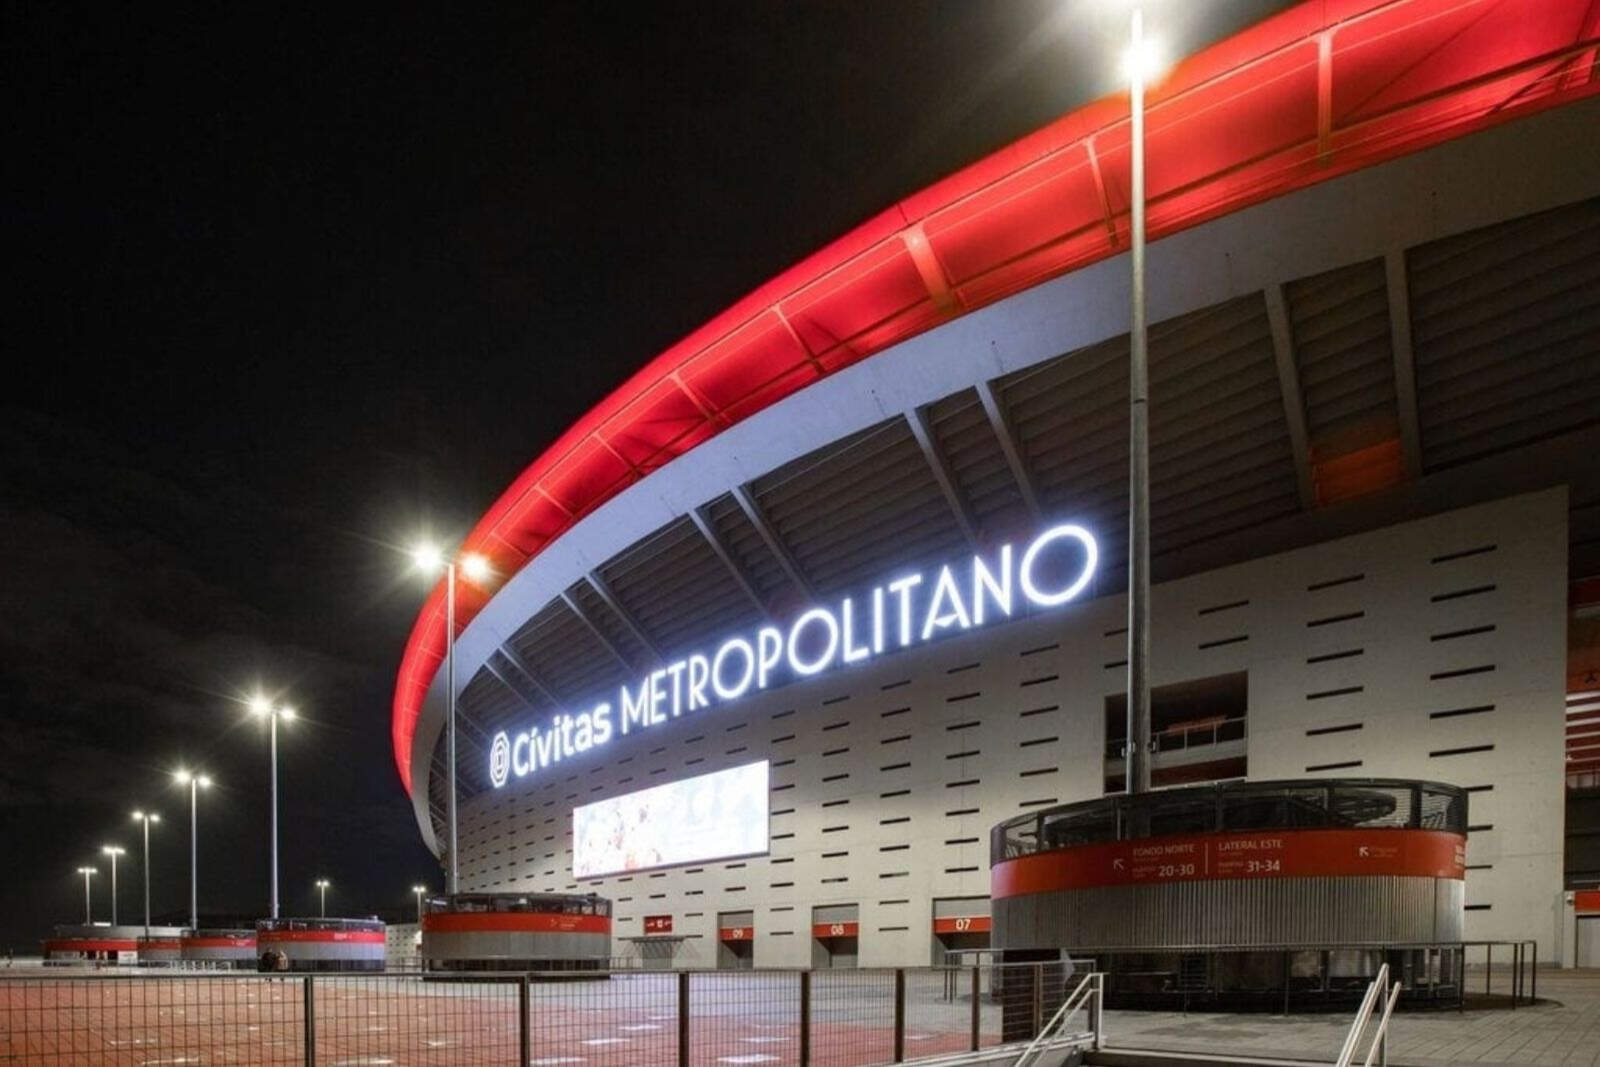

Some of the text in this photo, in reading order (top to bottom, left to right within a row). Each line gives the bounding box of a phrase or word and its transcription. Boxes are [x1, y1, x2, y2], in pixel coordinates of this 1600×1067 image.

[512, 524, 1099, 777] Cívitas METROPOLITANO
[1218, 838, 1283, 851] LATERAL ESTE
[1158, 863, 1195, 877] 20-30
[1247, 859, 1280, 873] 31-34
[955, 918, 971, 931] 07
